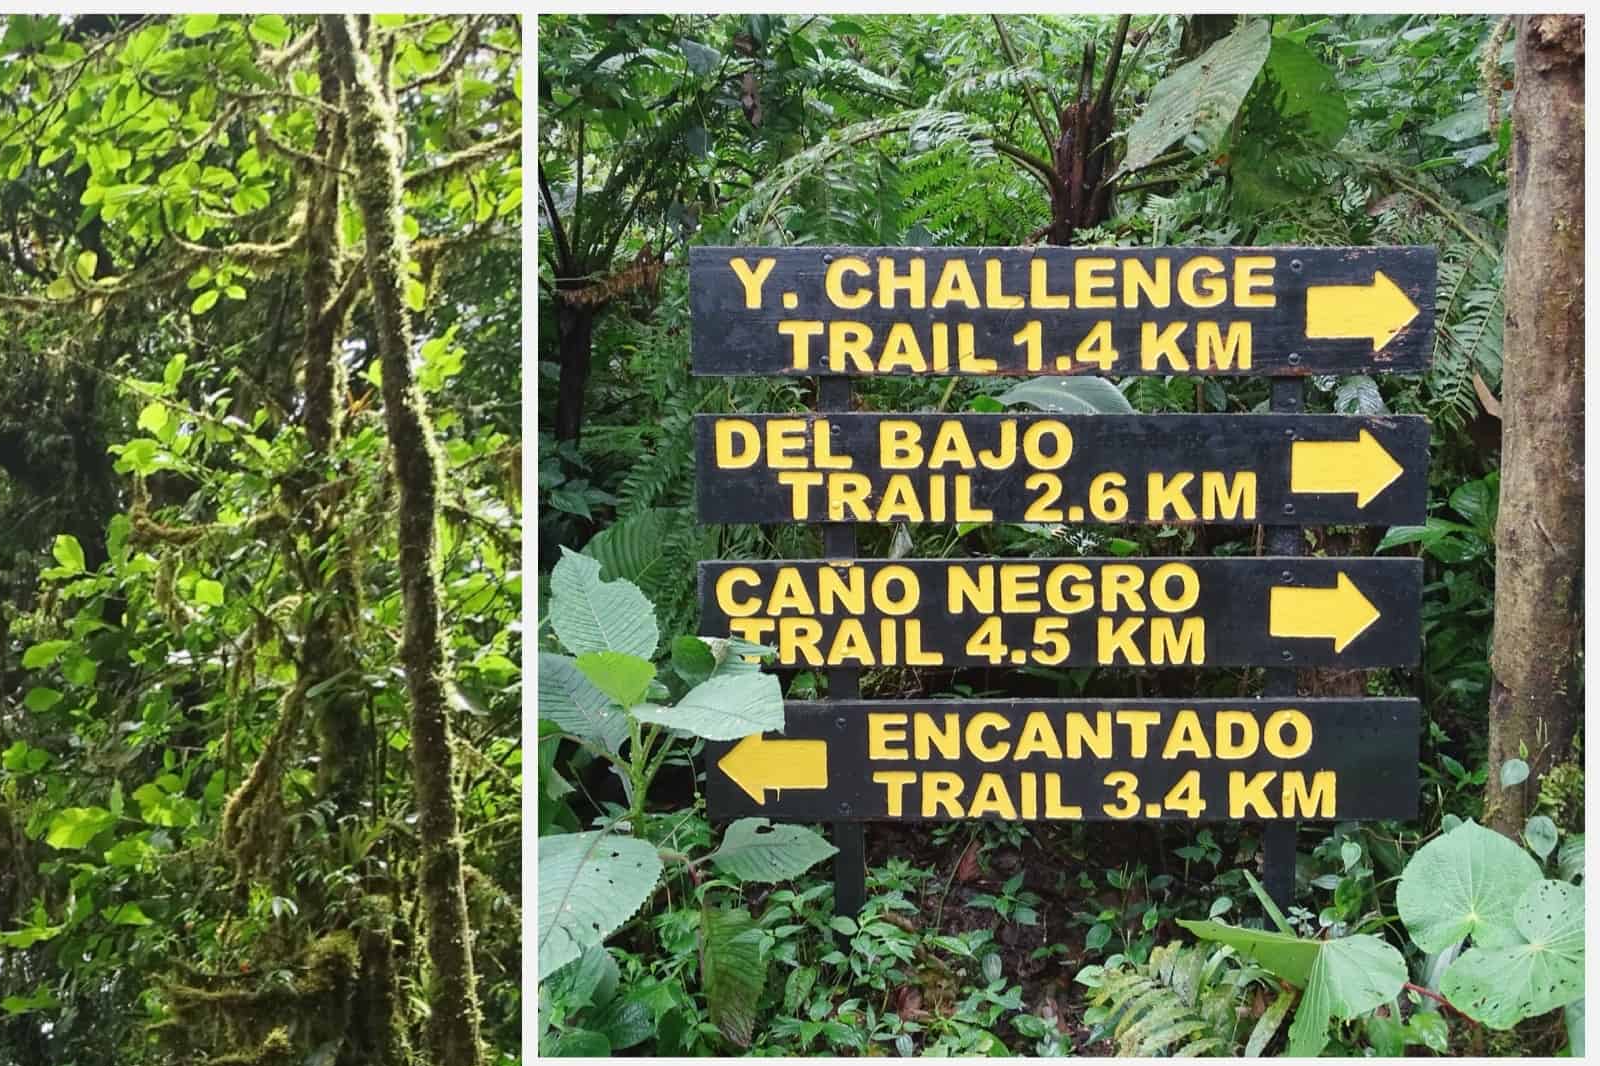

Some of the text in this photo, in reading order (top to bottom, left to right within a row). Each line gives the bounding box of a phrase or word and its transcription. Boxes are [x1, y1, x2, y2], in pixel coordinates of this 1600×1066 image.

[729, 255, 1276, 308] Y. CHALLENGE
[778, 320, 1252, 373] TRAIL 1.4 KM
[715, 419, 1074, 469] DEL BAJO
[777, 471, 1257, 522] TRAIL 2.6 KM
[947, 562, 1200, 614] NEGRO
[729, 616, 1205, 666] TRAIL 4.5 KM
[868, 709, 1313, 761] ENCANTADO
[872, 770, 1337, 819] TRAIL 3.4 KM
